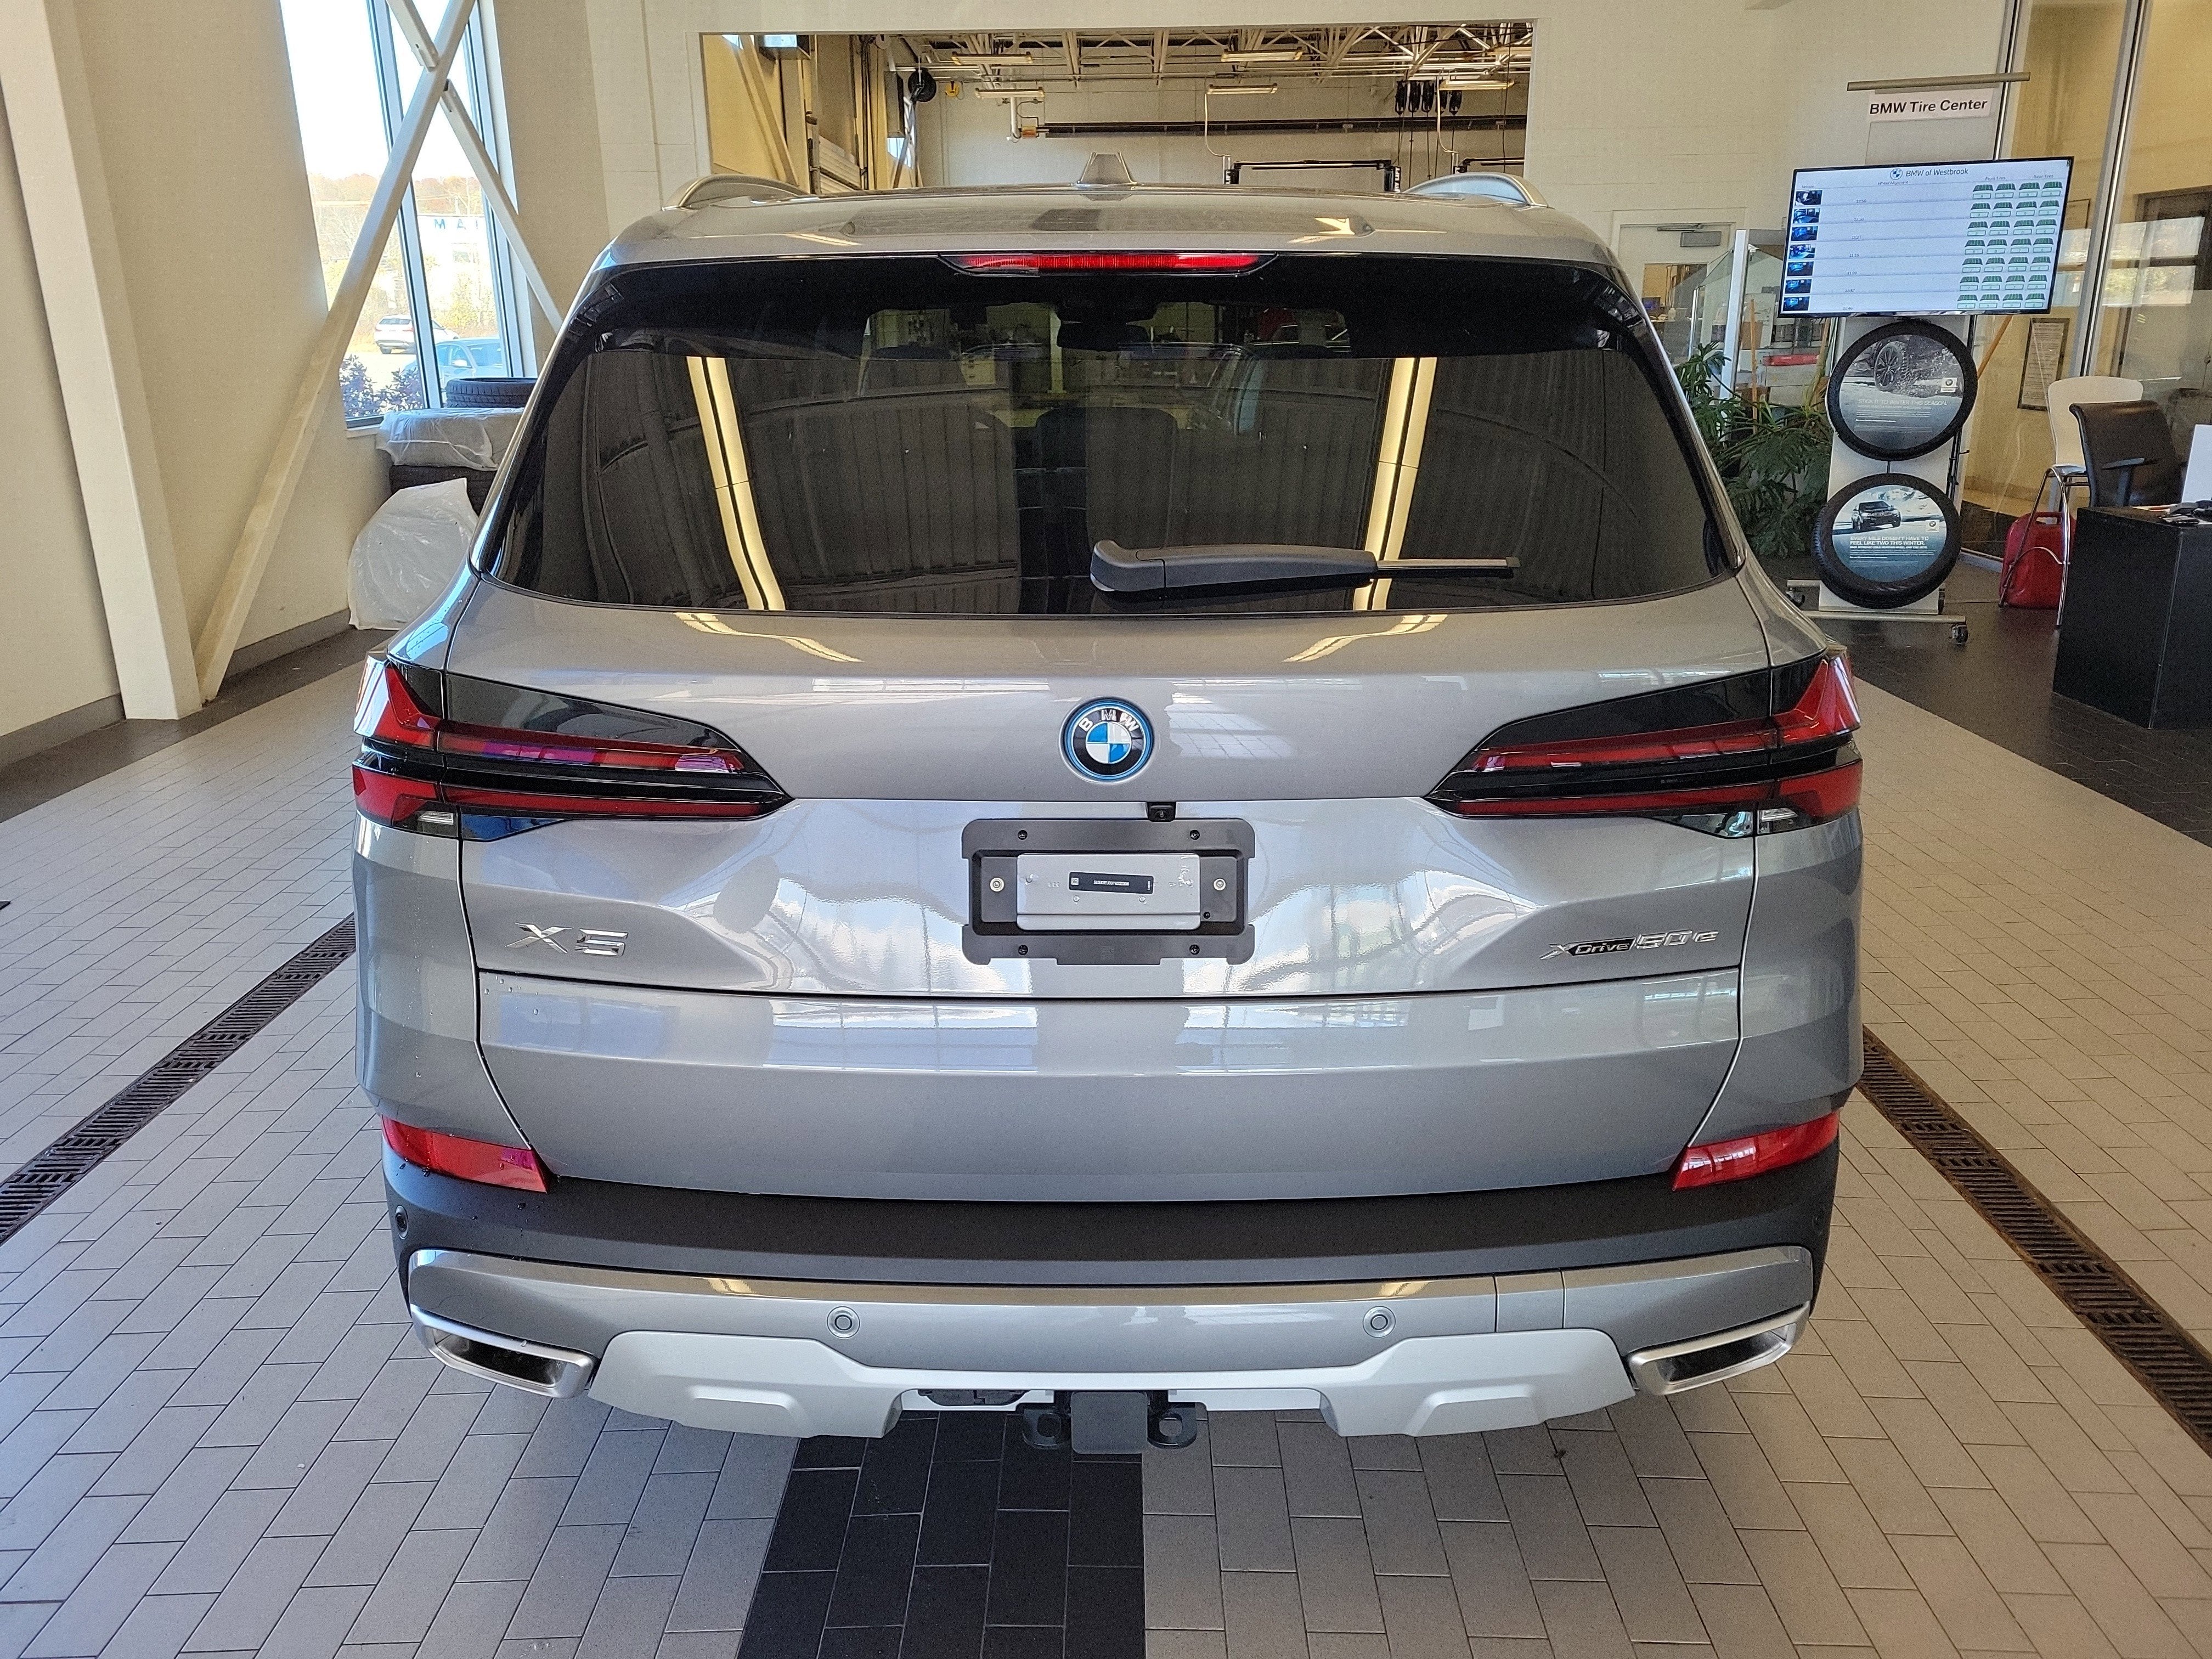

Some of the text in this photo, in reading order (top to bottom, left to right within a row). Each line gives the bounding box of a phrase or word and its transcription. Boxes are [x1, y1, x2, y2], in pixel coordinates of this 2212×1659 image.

[1869, 99, 1988, 114] BMW Tire Center
[1079, 709, 1140, 732] BMW
[505, 922, 629, 957] X5
